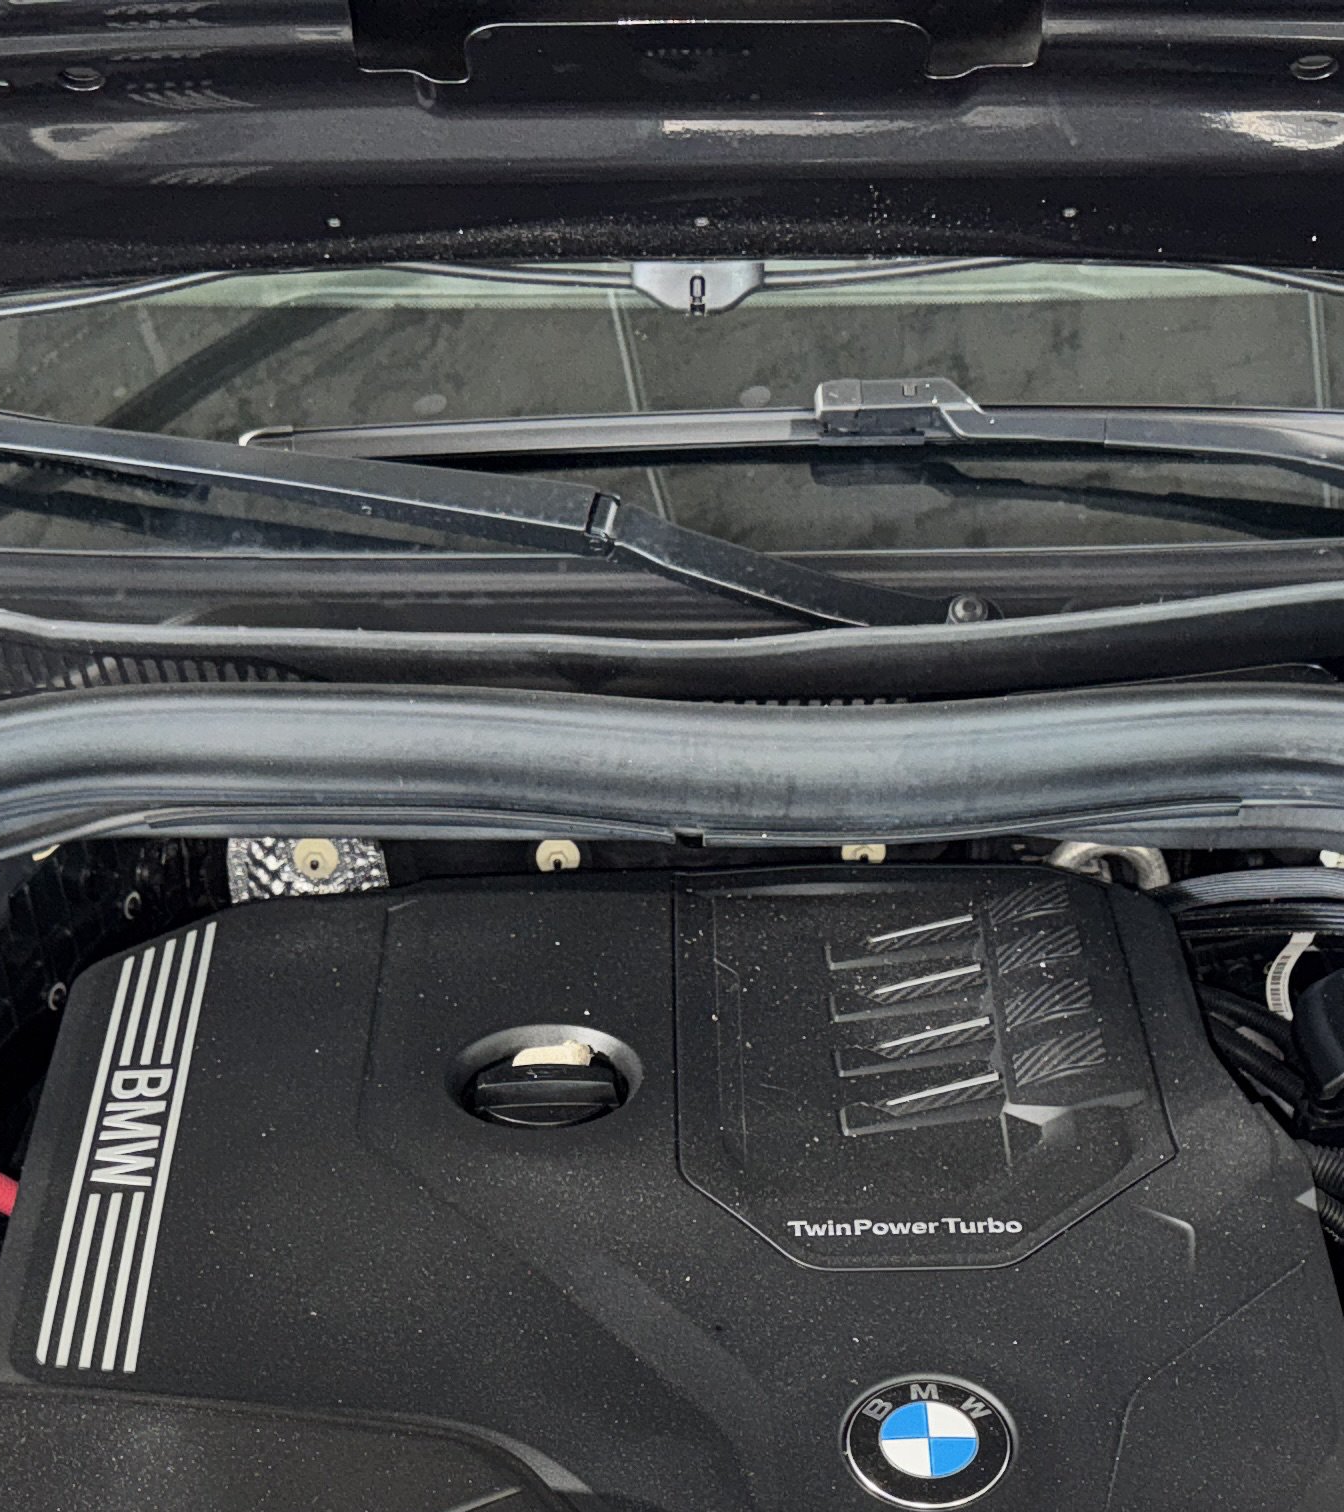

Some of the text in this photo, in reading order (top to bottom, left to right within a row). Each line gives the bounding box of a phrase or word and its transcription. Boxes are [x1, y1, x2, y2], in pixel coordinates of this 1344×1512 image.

[90, 1066, 174, 1188] BMW
[787, 1216, 1023, 1237] TwinPower Turbo
[862, 1383, 992, 1421] BMW
